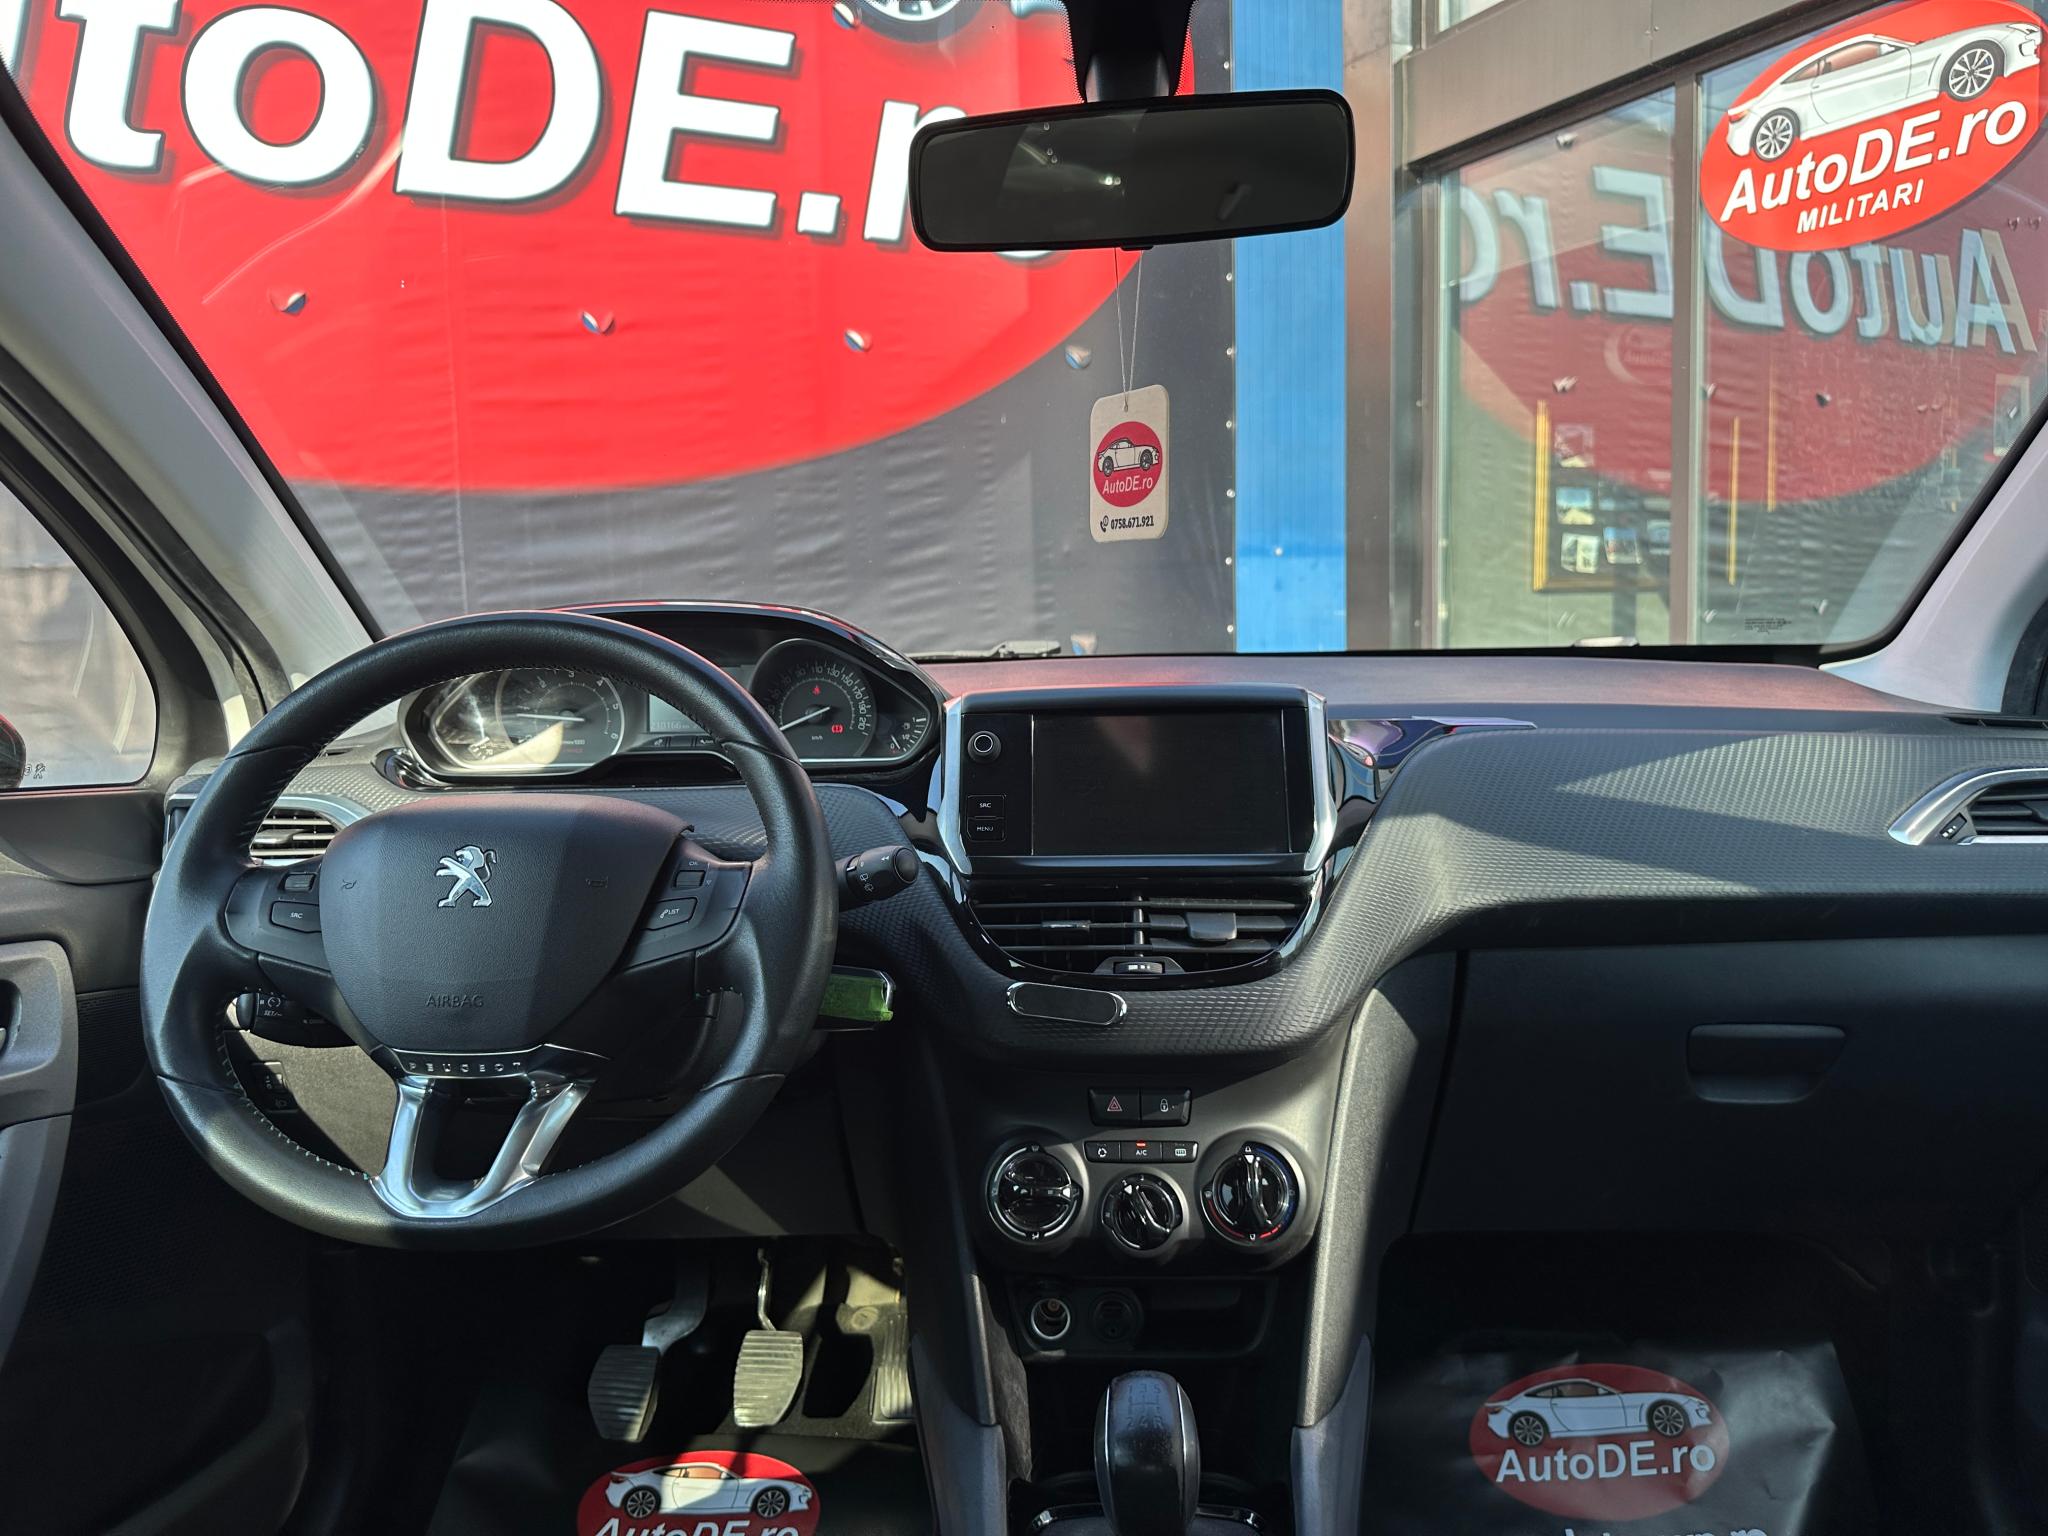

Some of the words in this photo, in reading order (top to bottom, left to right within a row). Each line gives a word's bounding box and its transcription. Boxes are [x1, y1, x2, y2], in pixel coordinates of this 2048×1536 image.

[0, 0, 1055, 258] toDE.r
[1719, 100, 2028, 222] AutoDE.ro
[1795, 178, 1925, 234] MILITARI
[1102, 475, 1154, 494] AutoDE.ro
[1110, 515, 1155, 530] 0758.671.921
[826, 667, 841, 678] 130
[841, 674, 854, 687] 150
[852, 686, 863, 700] 170
[857, 717, 867, 731] 210
[425, 994, 485, 1008] AIRBAG
[408, 1061, 521, 1074] PEUGEOT
[1495, 1439, 1717, 1483] AutoDE.ro
